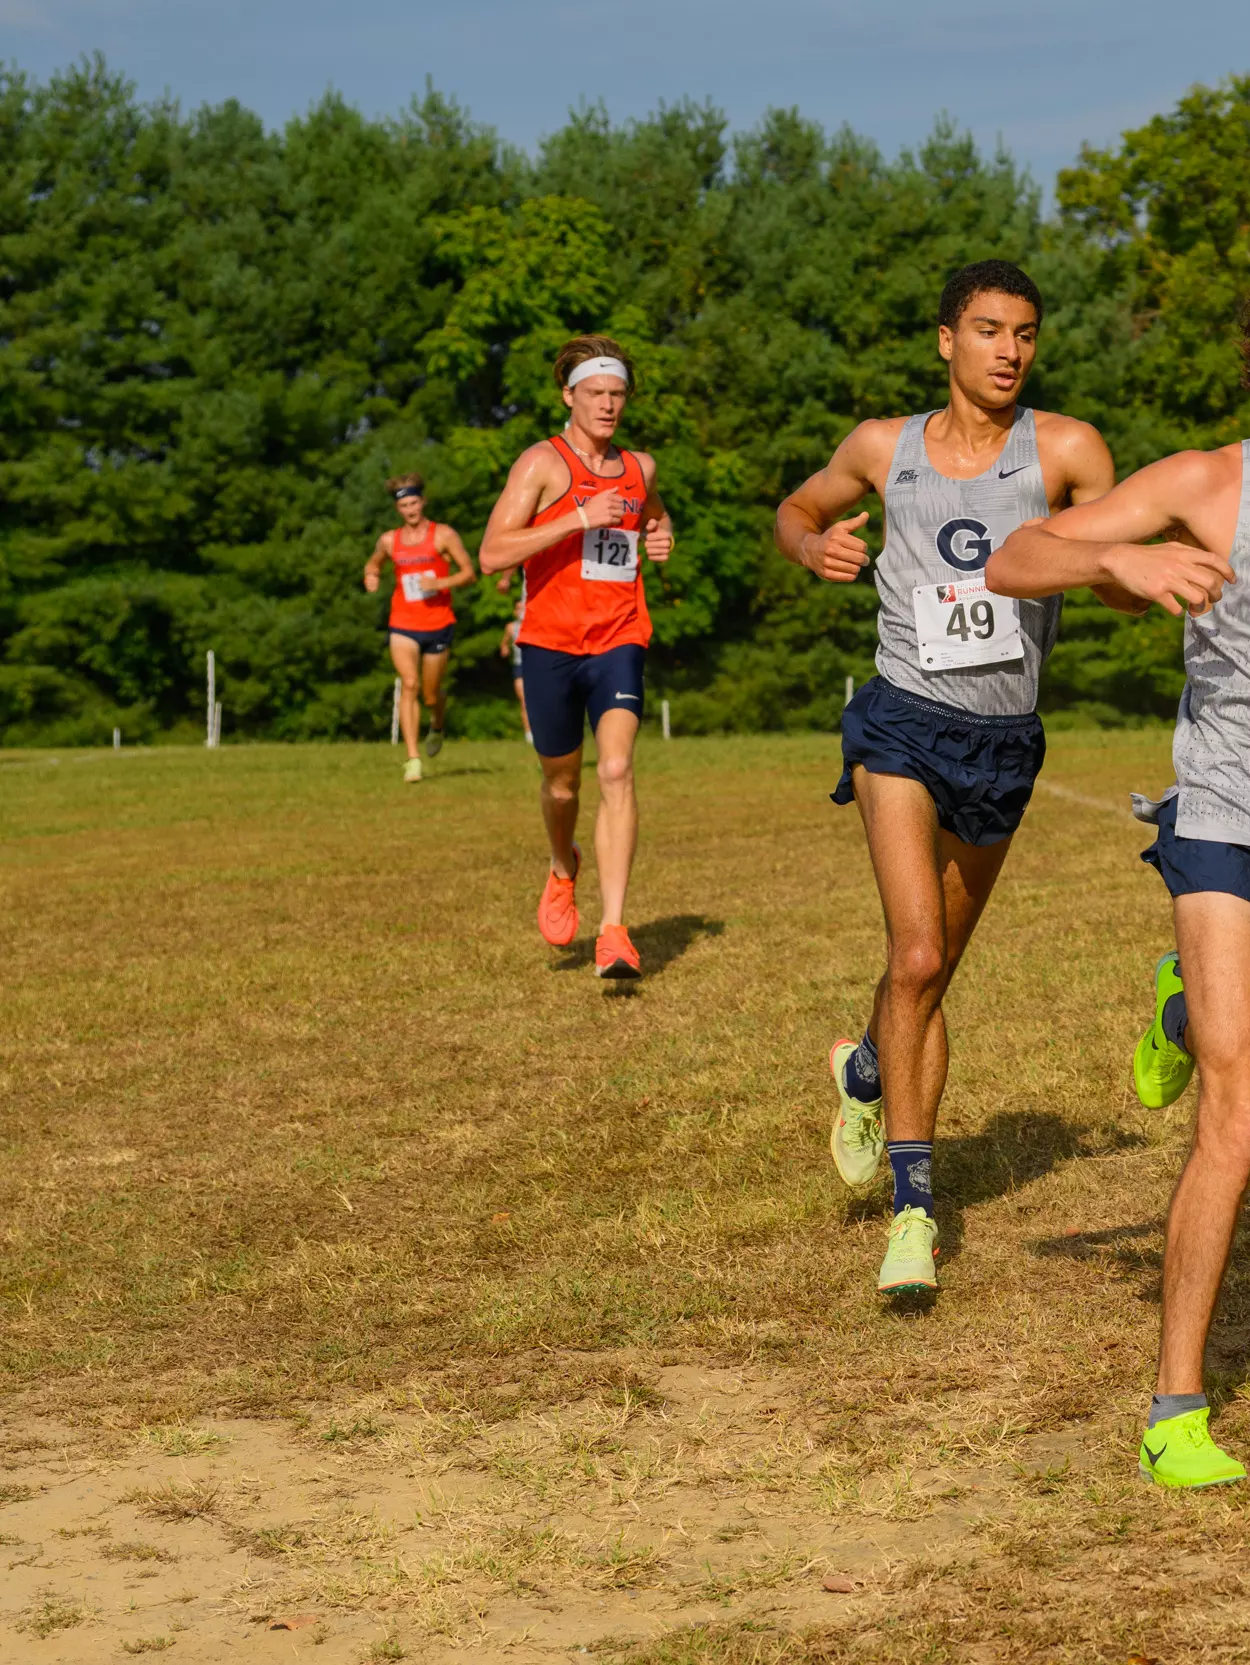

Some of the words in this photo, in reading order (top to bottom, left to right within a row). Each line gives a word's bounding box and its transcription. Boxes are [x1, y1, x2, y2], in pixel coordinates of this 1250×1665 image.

[594, 542, 629, 565] 127
[935, 517, 996, 574] G
[957, 585, 988, 596] RUNNI
[946, 599, 995, 642] 49
